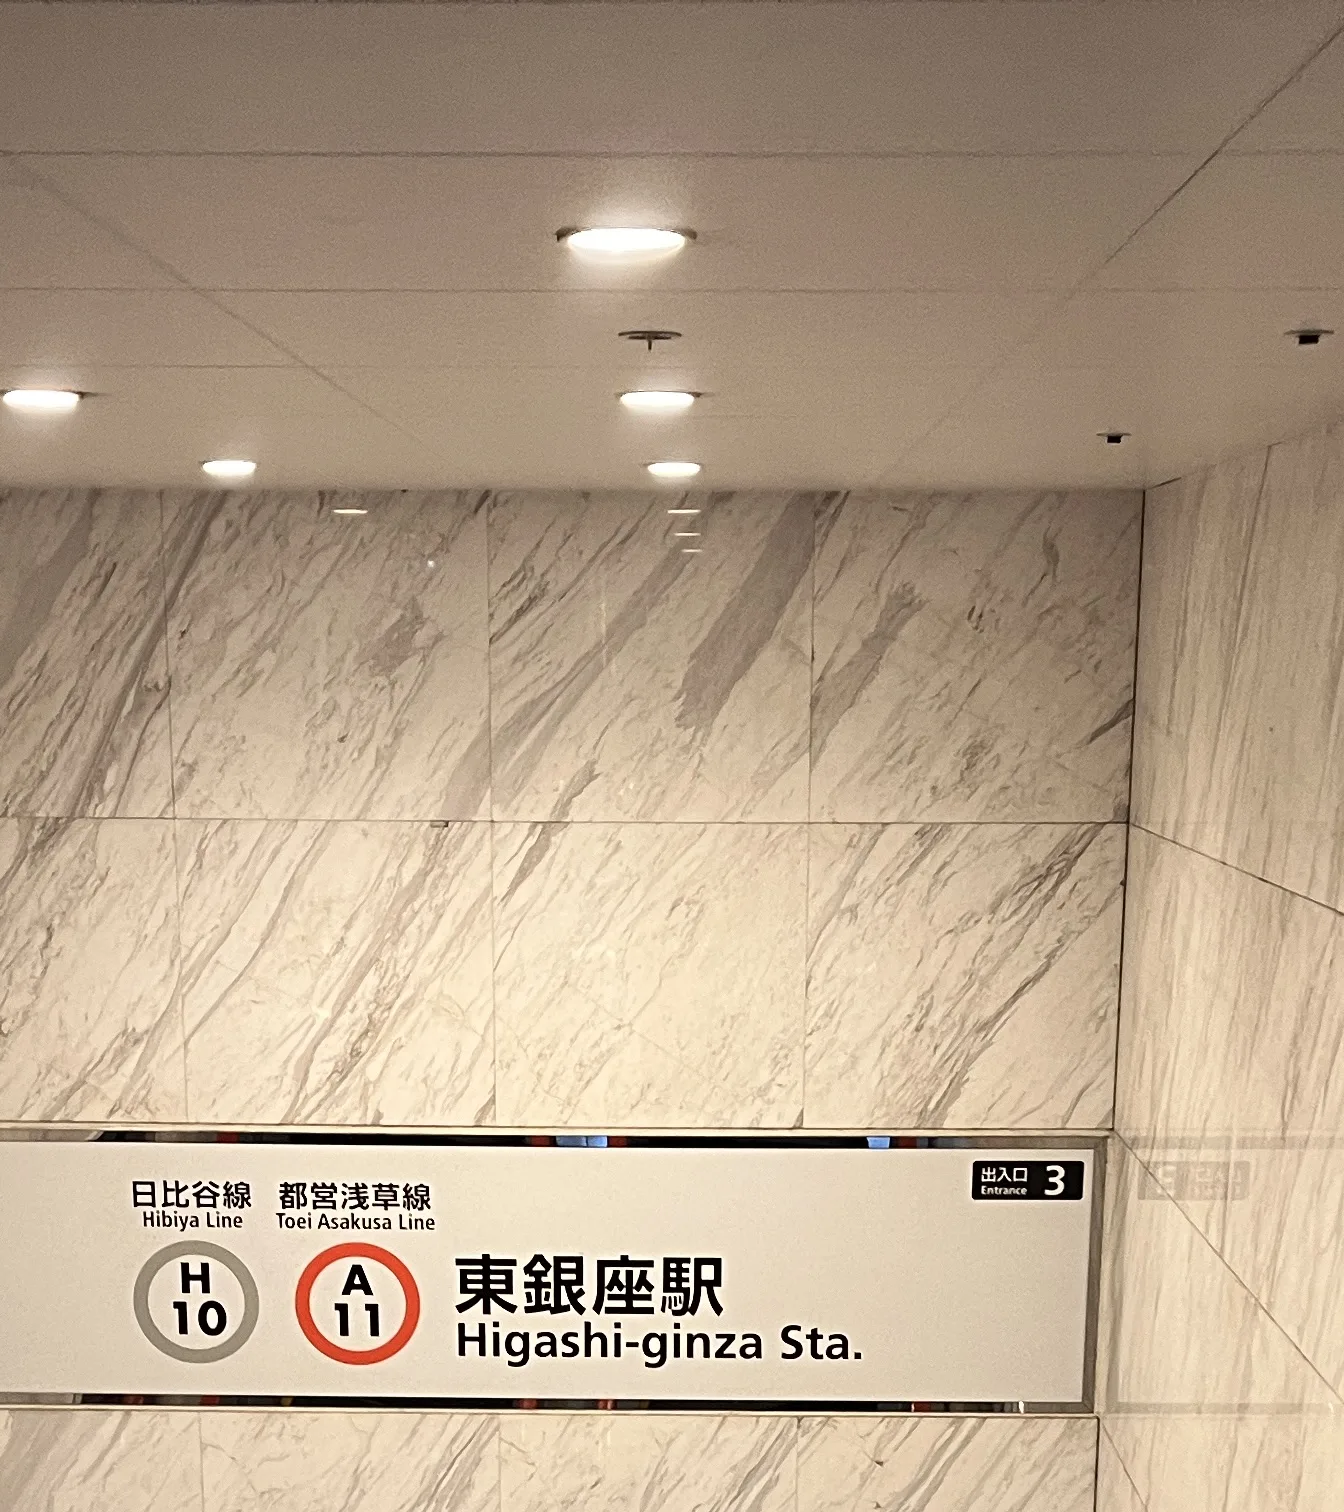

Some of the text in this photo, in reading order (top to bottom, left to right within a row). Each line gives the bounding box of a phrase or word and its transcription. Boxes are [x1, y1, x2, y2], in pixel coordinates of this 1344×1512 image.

[981, 1166, 1028, 1183] 出入口
[1043, 1165, 1066, 1196] 3
[132, 1180, 252, 1209] 日比谷線
[278, 1182, 432, 1211] 都営浅草線
[980, 1185, 1028, 1196] Entrance
[143, 1211, 244, 1232] Hibiya Line
[276, 1212, 436, 1231] Toei Asakusa Line
[180, 1262, 211, 1294] H
[341, 1264, 374, 1296] A
[454, 1255, 724, 1318] 東銀座駅
[173, 1300, 227, 1336] 10
[334, 1302, 380, 1337] 11
[456, 1323, 865, 1370] Higashi-ginza Sta.
